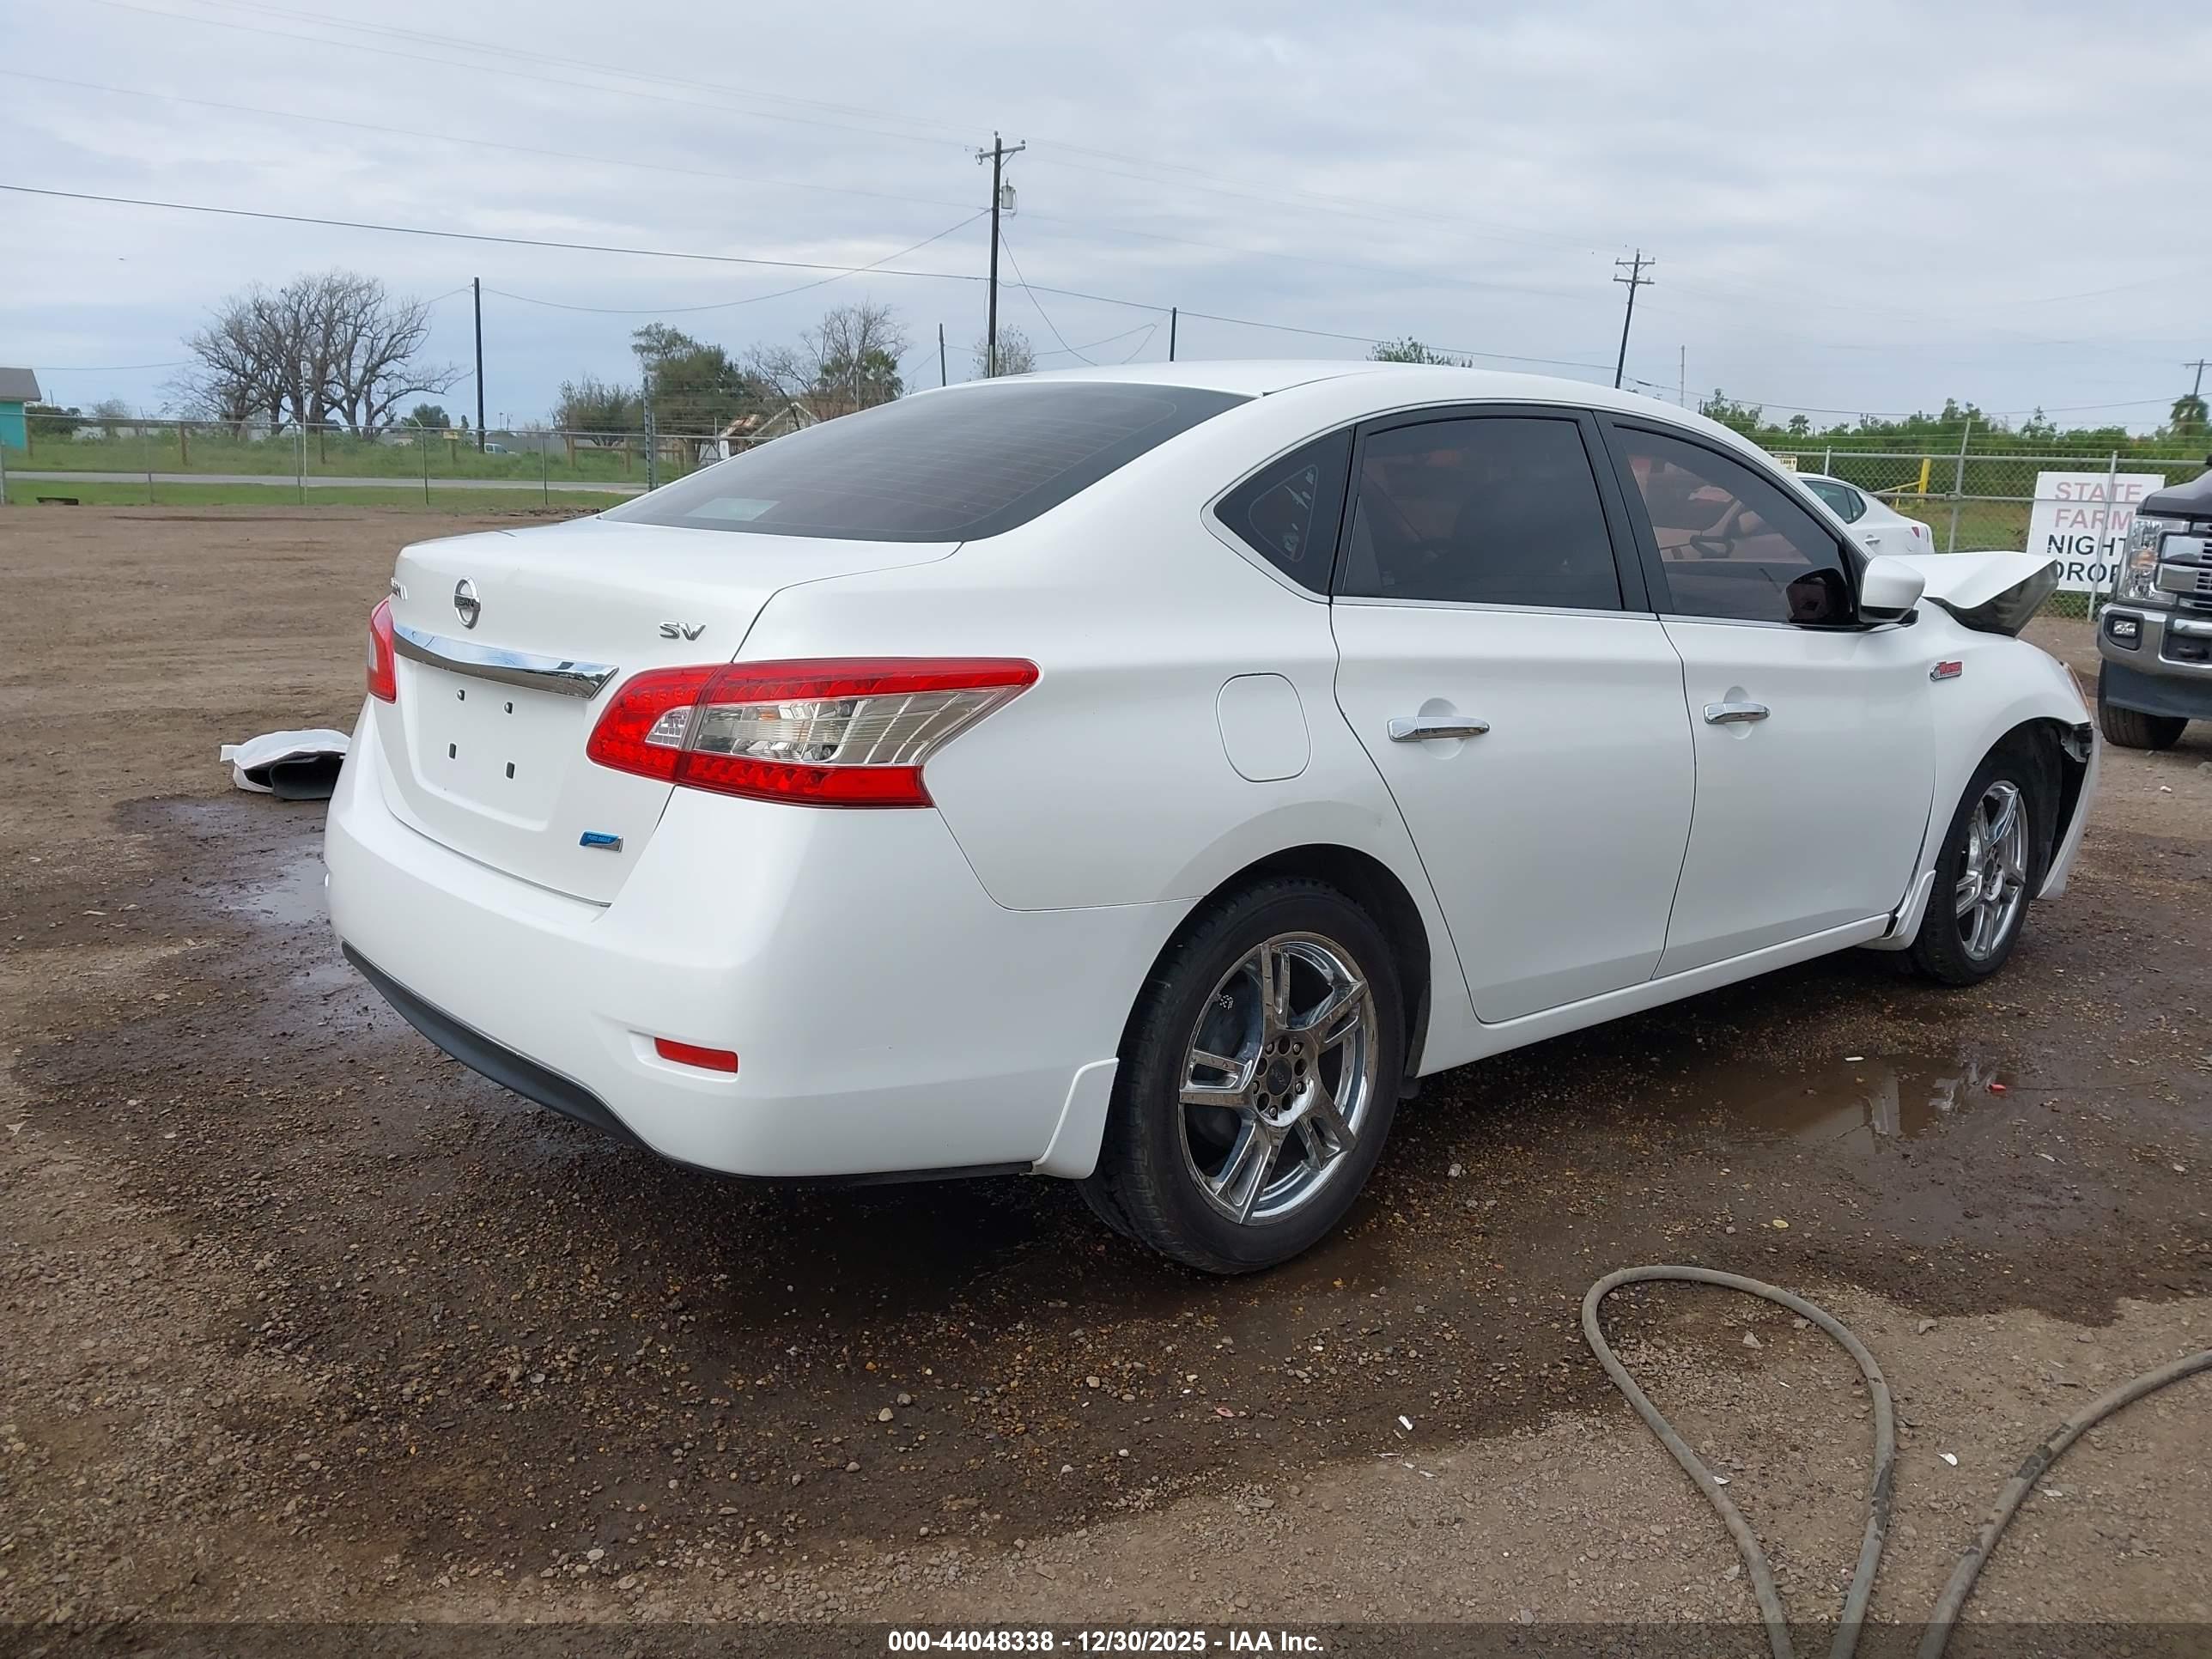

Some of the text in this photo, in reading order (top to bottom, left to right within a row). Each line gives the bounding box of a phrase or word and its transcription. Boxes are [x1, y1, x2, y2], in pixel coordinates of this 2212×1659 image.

[2055, 482, 2142, 503] STATE
[2054, 507, 2134, 531] FARM
[659, 622, 707, 641] SV
